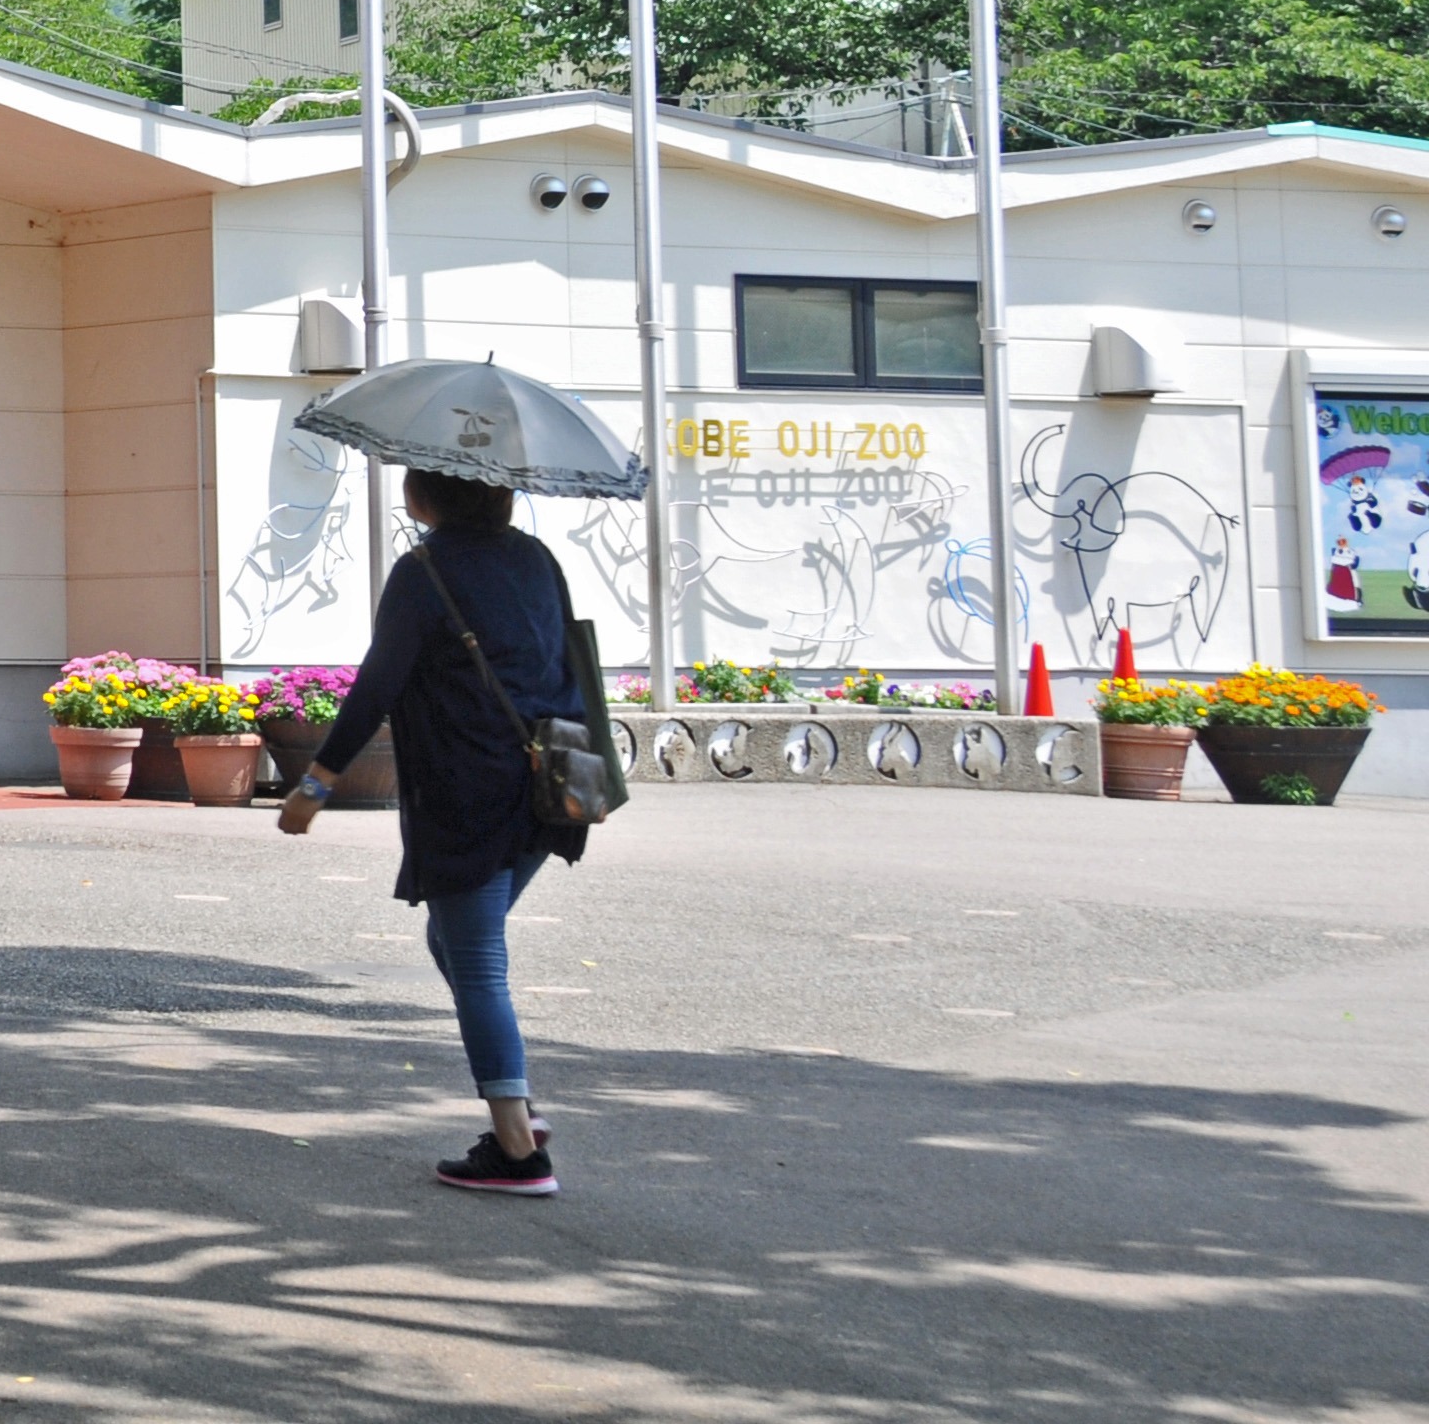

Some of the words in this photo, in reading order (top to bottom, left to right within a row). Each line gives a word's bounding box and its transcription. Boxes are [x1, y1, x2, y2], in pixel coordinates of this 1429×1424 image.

[666, 419, 750, 458] OBE
[778, 420, 832, 458] OJI
[855, 422, 926, 460] ZOO
